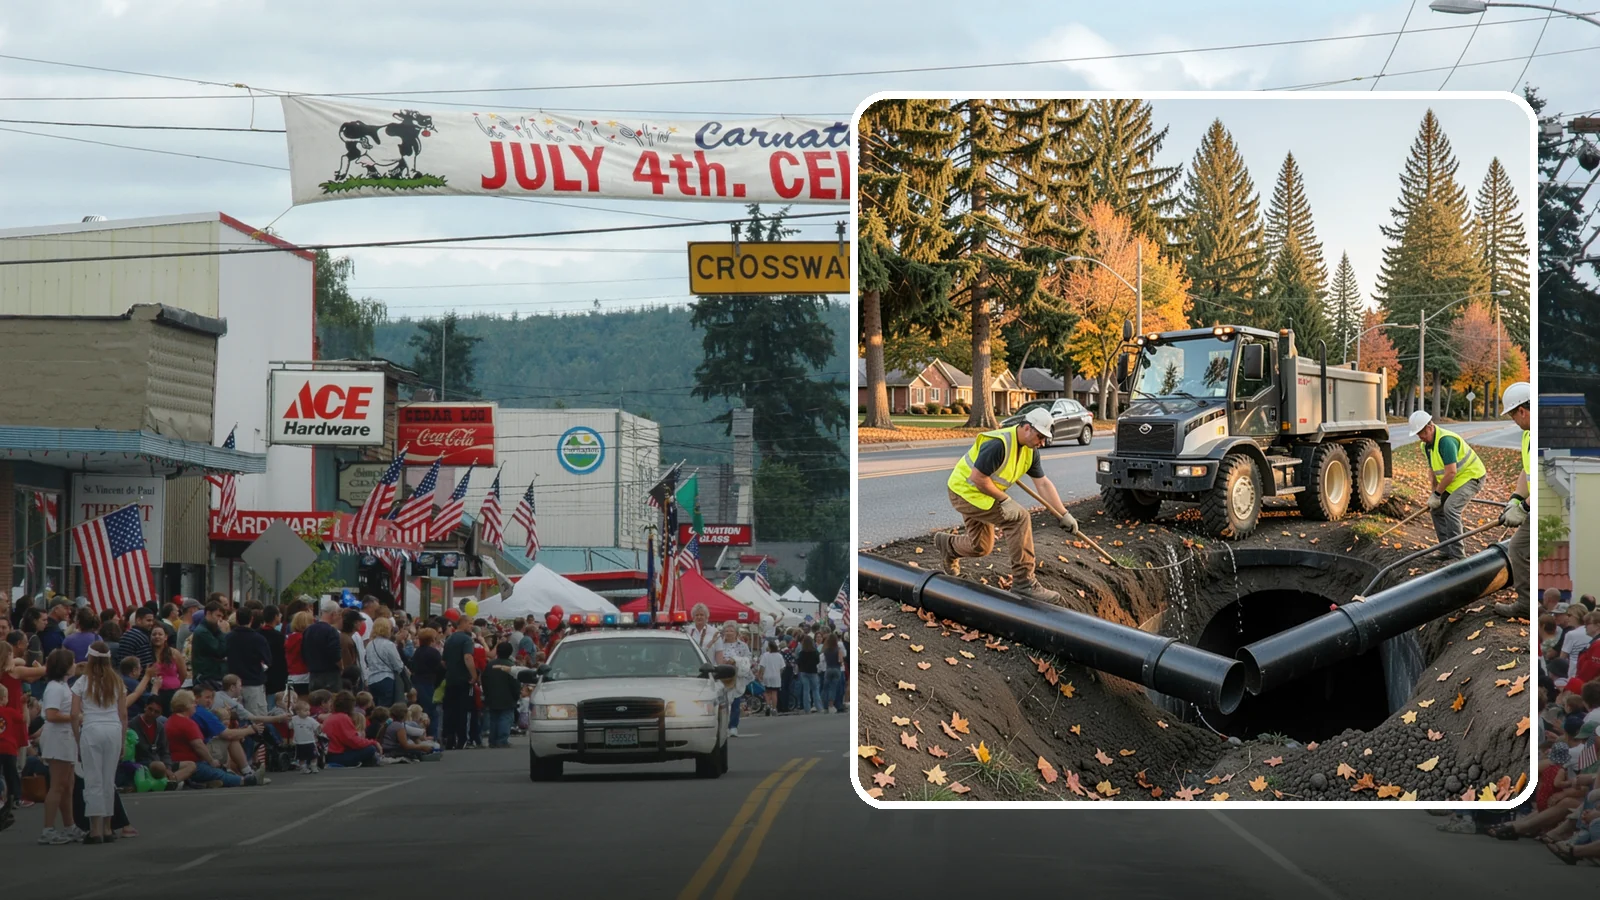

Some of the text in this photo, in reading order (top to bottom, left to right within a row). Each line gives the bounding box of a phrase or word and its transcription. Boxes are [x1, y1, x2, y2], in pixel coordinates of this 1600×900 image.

[481, 141, 604, 192] JULY
[632, 150, 746, 198] 4th.
[697, 254, 850, 279] CROSSWA
[282, 380, 373, 420] ACE
[283, 421, 371, 436] Hardware
[95, 485, 124, 494] Vincent
[126, 486, 136, 494] de
[138, 486, 155, 495] Paul
[688, 526, 741, 535] CRNATION
[699, 535, 730, 543] GLASS
